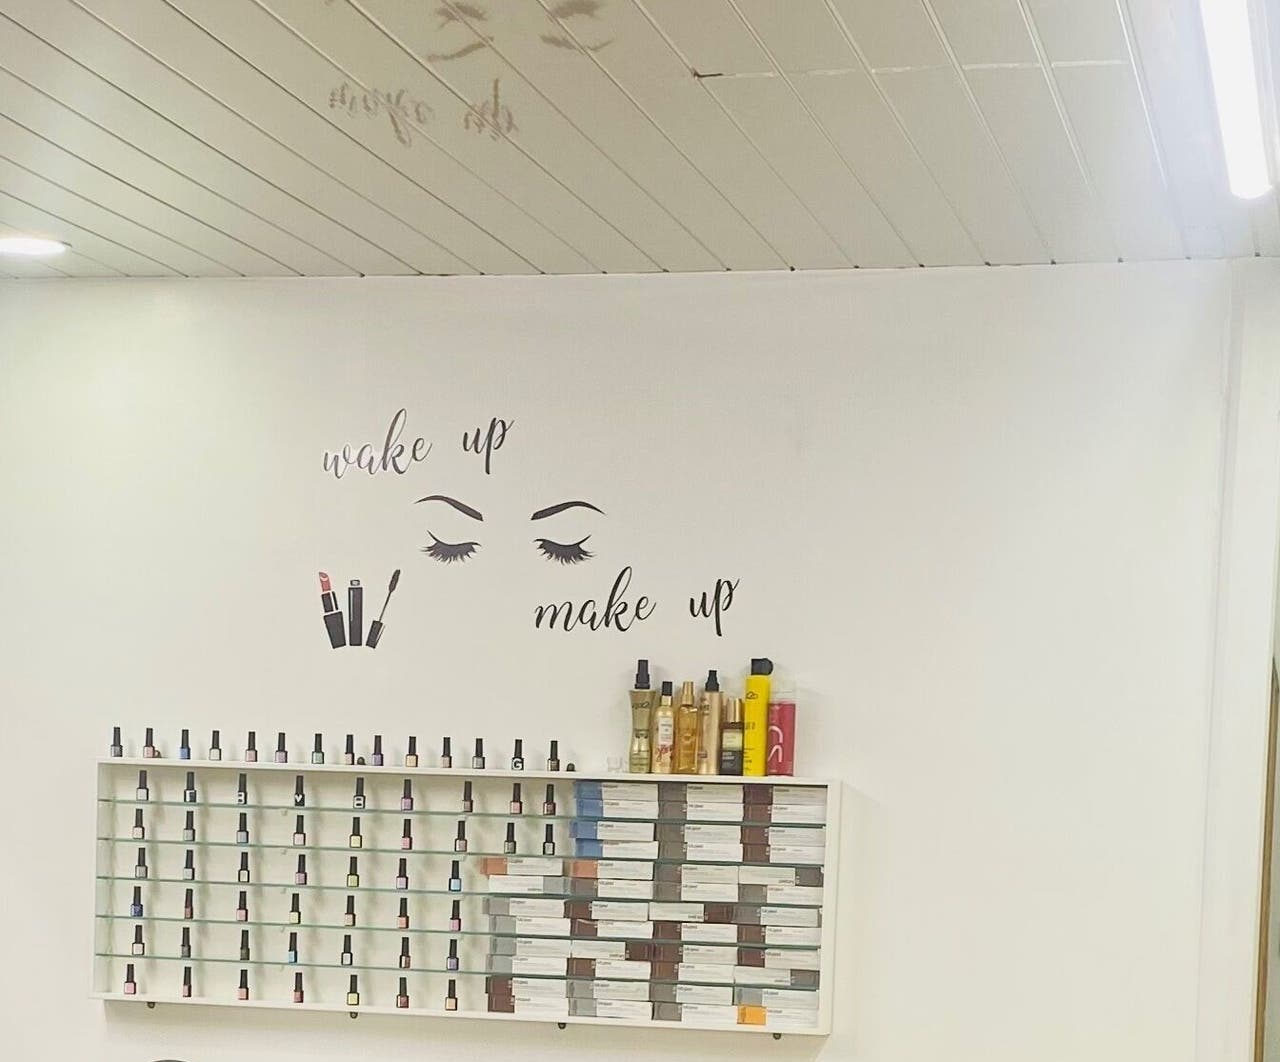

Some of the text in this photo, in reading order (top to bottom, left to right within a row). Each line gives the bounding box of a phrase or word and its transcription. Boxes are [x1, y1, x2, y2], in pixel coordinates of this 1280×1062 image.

[322, 408, 514, 479] wake up
[534, 566, 740, 637] make up
